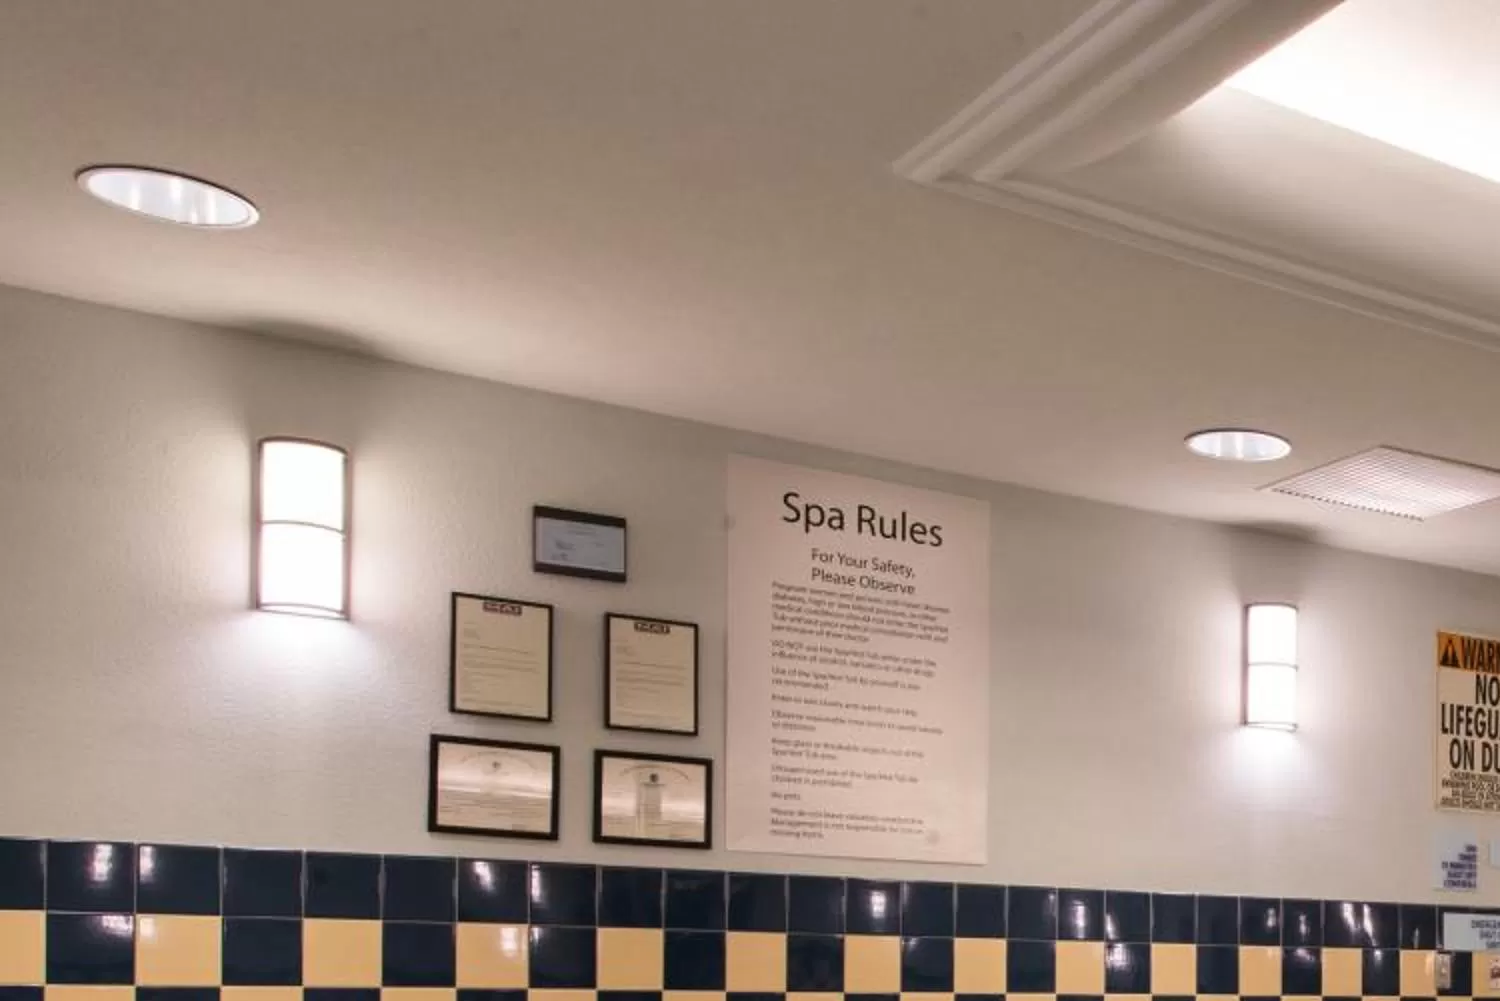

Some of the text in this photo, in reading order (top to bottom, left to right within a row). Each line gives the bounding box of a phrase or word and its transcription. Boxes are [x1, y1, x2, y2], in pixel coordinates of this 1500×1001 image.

[783, 491, 943, 547] Spa Rules
[811, 548, 834, 564] For
[837, 551, 869, 569] Your
[811, 567, 916, 595] Please Observe
[1475, 673, 1500, 707] NO
[1449, 738, 1475, 771] ON
